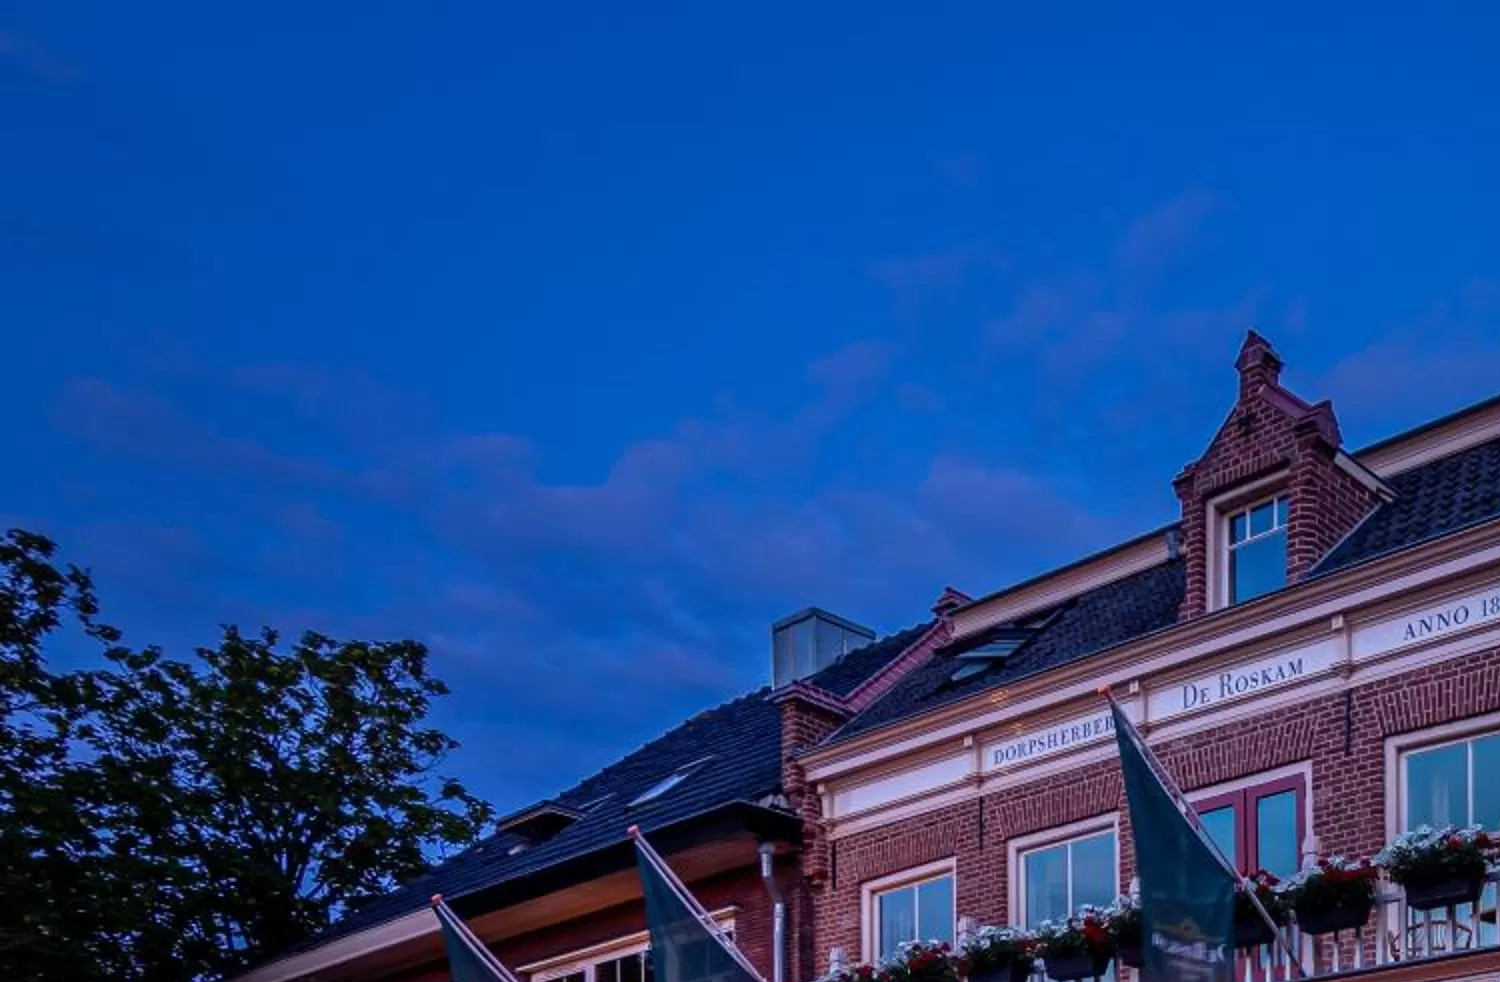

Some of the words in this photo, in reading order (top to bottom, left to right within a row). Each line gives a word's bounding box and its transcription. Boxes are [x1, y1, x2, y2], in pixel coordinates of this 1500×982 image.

[1403, 606, 1470, 641] ANNO
[1219, 658, 1303, 697] ROSKAM
[993, 715, 1116, 765] DORPSHERBER
